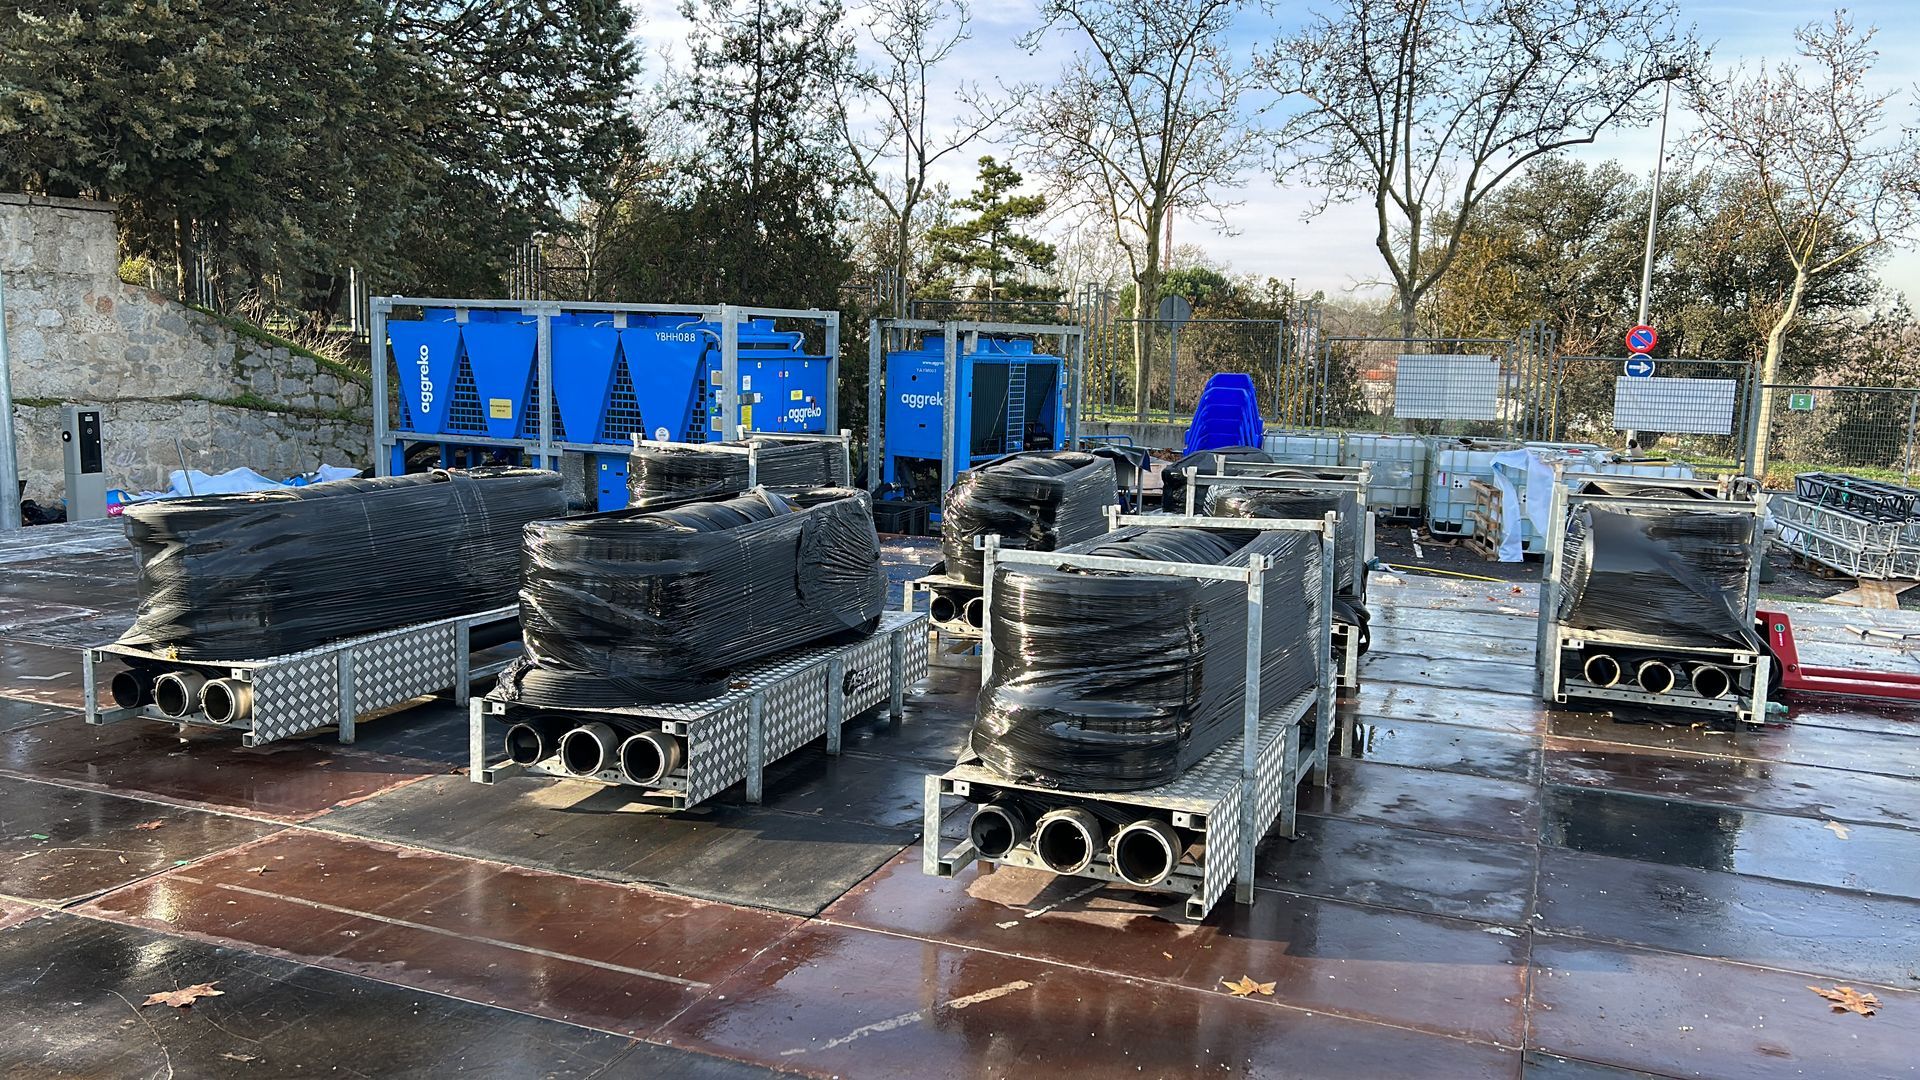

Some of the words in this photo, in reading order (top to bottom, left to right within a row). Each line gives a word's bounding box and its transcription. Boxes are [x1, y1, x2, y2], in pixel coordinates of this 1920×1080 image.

[655, 332, 696, 342] YBHH088
[416, 344, 433, 413] aggreko
[901, 391, 944, 409] aggrek
[788, 405, 821, 423] aggreko
